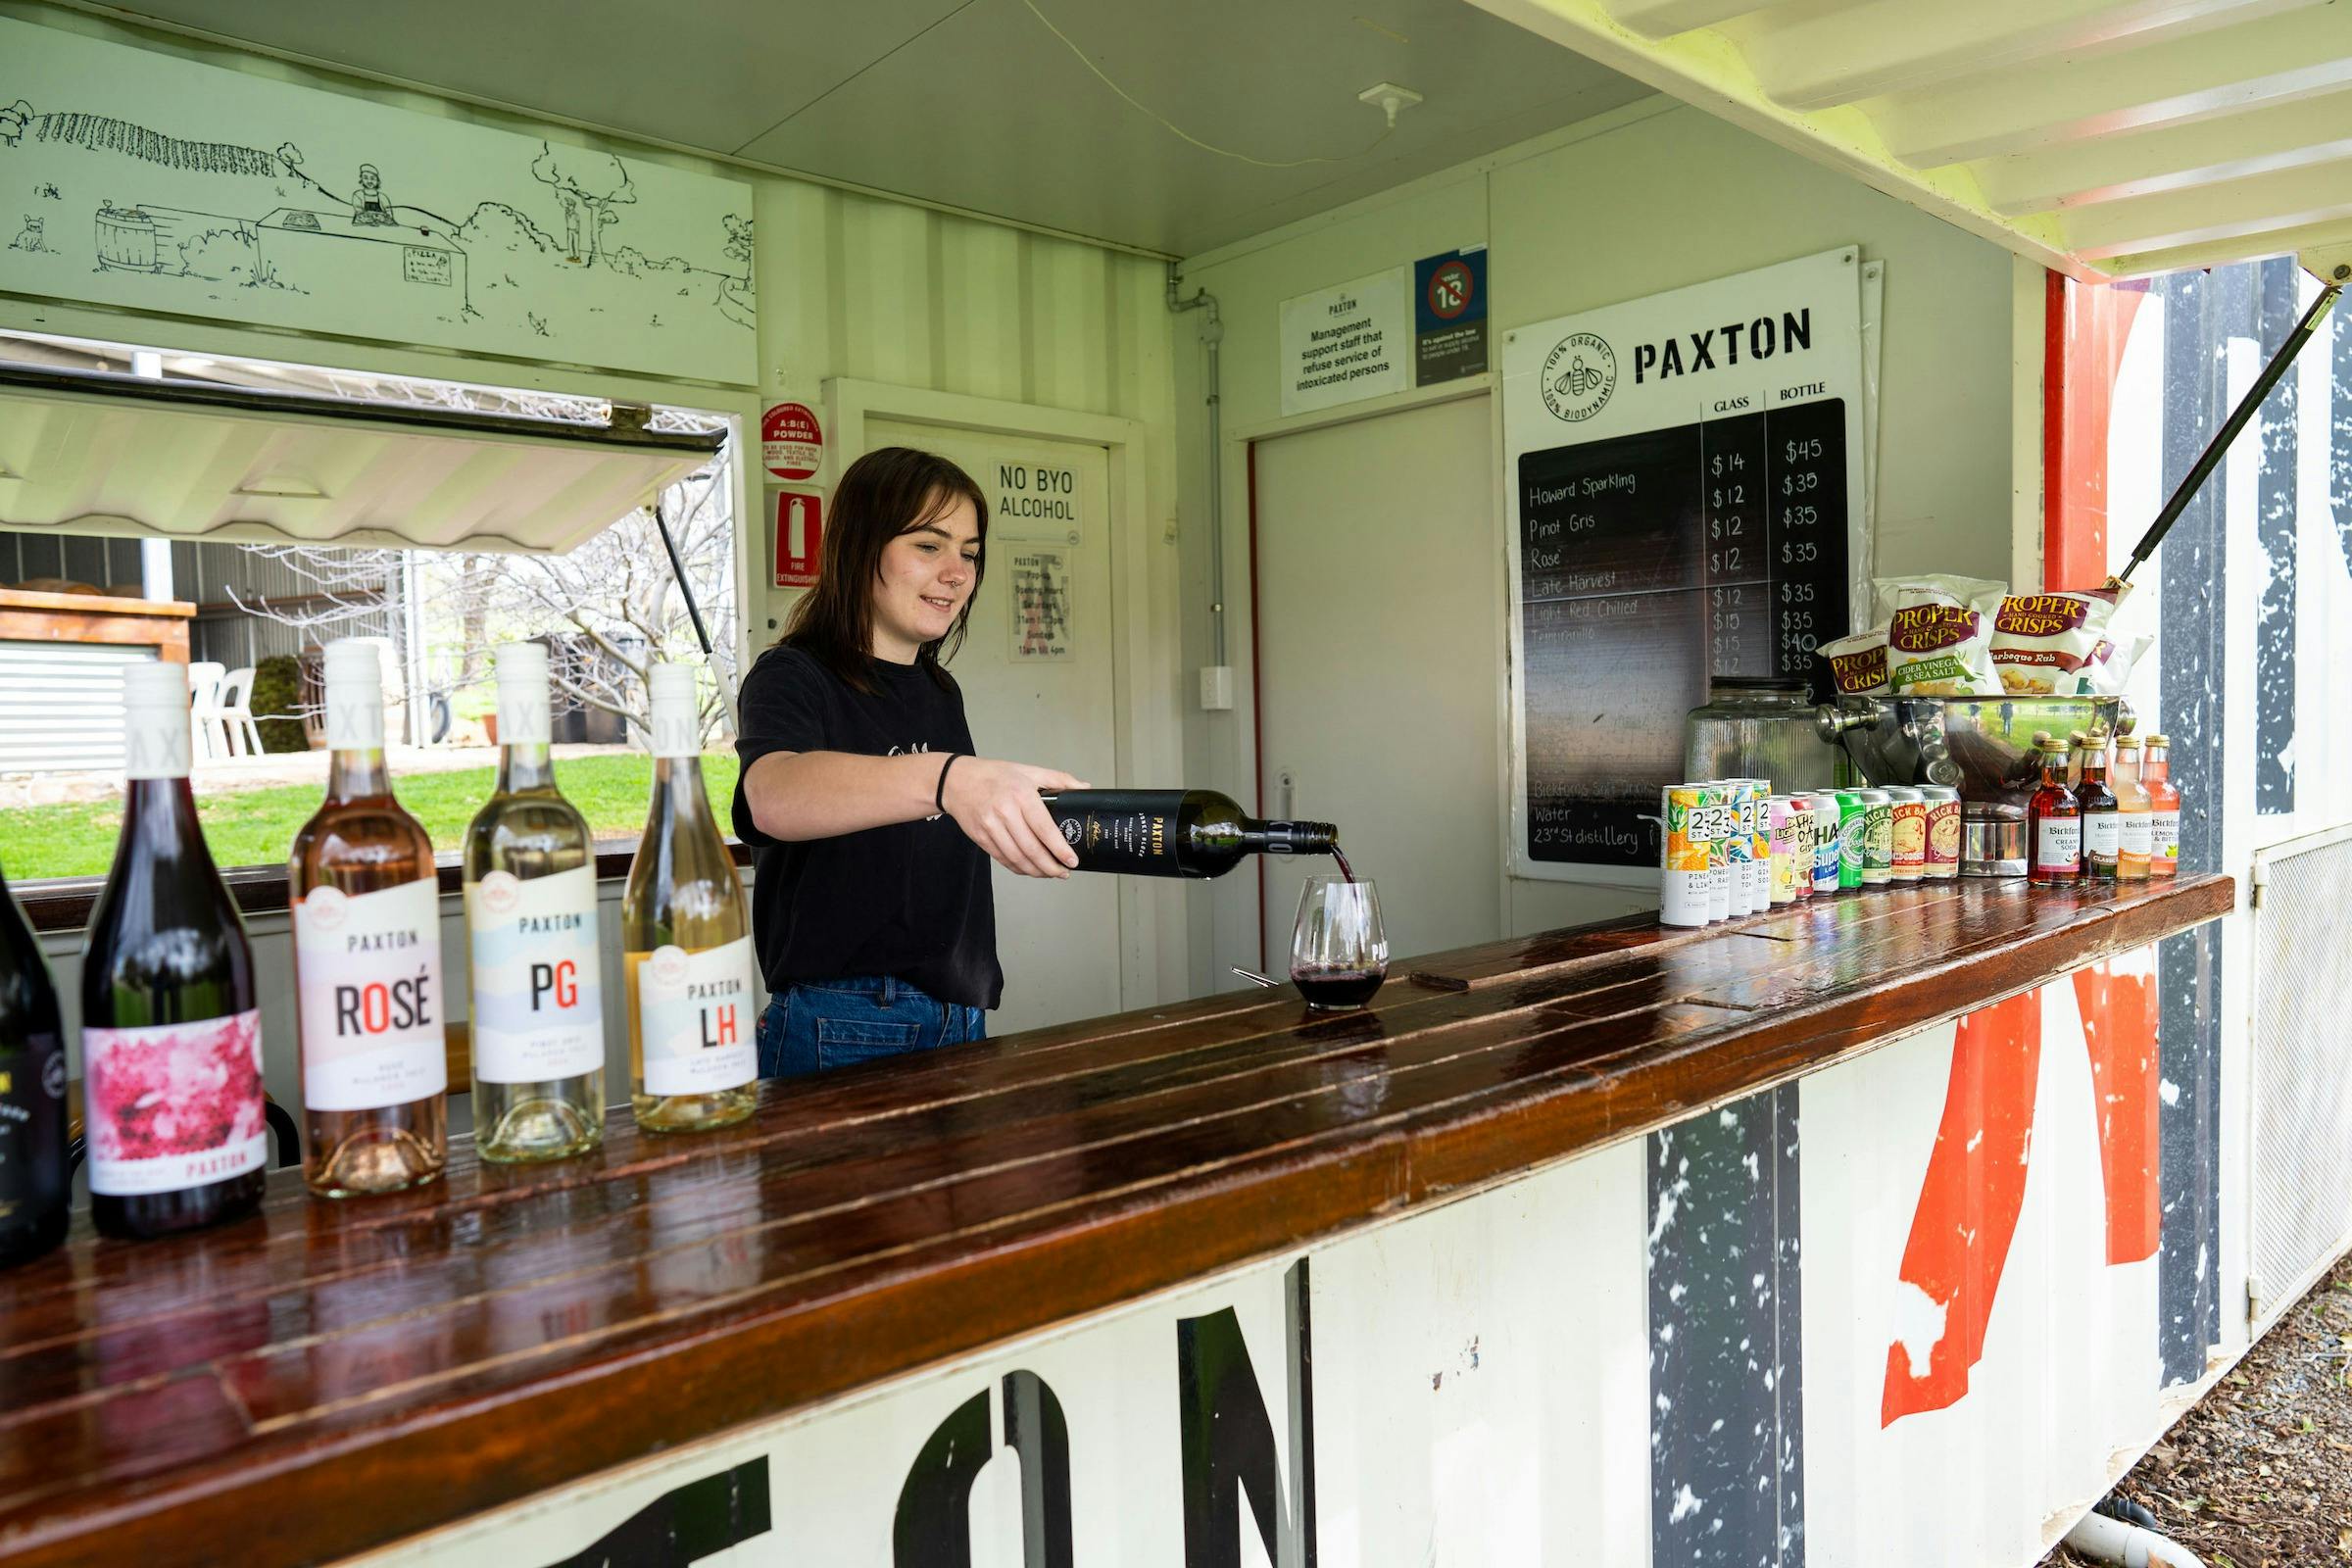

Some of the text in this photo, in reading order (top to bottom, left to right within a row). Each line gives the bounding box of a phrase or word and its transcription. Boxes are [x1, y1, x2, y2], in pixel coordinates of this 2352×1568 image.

[1437, 280, 1462, 309] 18
[1329, 299, 1357, 316] PAXTON
[1310, 317, 1372, 342] Management
[1301, 329, 1383, 361] support staff that
[1546, 336, 1610, 370] 100% ORGANIC
[1634, 308, 1812, 385] PAXTON
[1302, 345, 1383, 374] refuse service of
[1297, 362, 1390, 392] intoxicated persons
[1564, 375, 1614, 418] BIODYNAMIC
[1714, 381, 1826, 414] GLASS BOTTLE
[773, 429, 813, 440] POWDER
[1786, 439, 1823, 465] $45
[1000, 465, 1073, 494] NO BYO
[1529, 473, 1636, 508] Howard Sparkling
[1782, 471, 1818, 497] $35
[1000, 496, 1074, 520] ALCOHOL
[1783, 506, 1818, 529] $35
[1529, 514, 1595, 542] Pinot Gris
[1013, 557, 1039, 566] PAXTON
[1782, 541, 1817, 564] $35
[791, 562, 805, 571] FIRE
[1532, 571, 1616, 598] Late Harvest
[1781, 582, 1815, 604] $35
[1531, 599, 1639, 628] Light Red Chilled
[1713, 610, 1813, 632] $15 $35
[1893, 604, 1973, 633] PROPER
[1997, 617, 2064, 634] CRISPS
[1712, 632, 1818, 655] $15 $40
[1900, 627, 1960, 649] CRISPS
[1051, 646, 1066, 656] 4pm
[1832, 647, 1887, 678] PROP
[1990, 651, 2056, 663] arbeque Rub
[1712, 653, 1813, 676] $12 $35
[1897, 664, 1922, 676] CIDER
[1905, 666, 1956, 682] & SEA SALT
[1533, 806, 1572, 822] Water
[1930, 806, 1953, 822] KICK
[1138, 812, 1148, 858] JONES BLOCK
[1152, 816, 1164, 856] PAXTON
[1560, 827, 1573, 845] St
[1575, 824, 1639, 855] distillery
[518, 913, 582, 934] PAXTON
[347, 930, 418, 954] PAXTON
[530, 958, 578, 1011] PG
[688, 978, 742, 1001] PAXTON
[335, 963, 431, 1037] ROSÉ
[700, 1004, 738, 1049] LH
[185, 1152, 248, 1177] PAXTON
